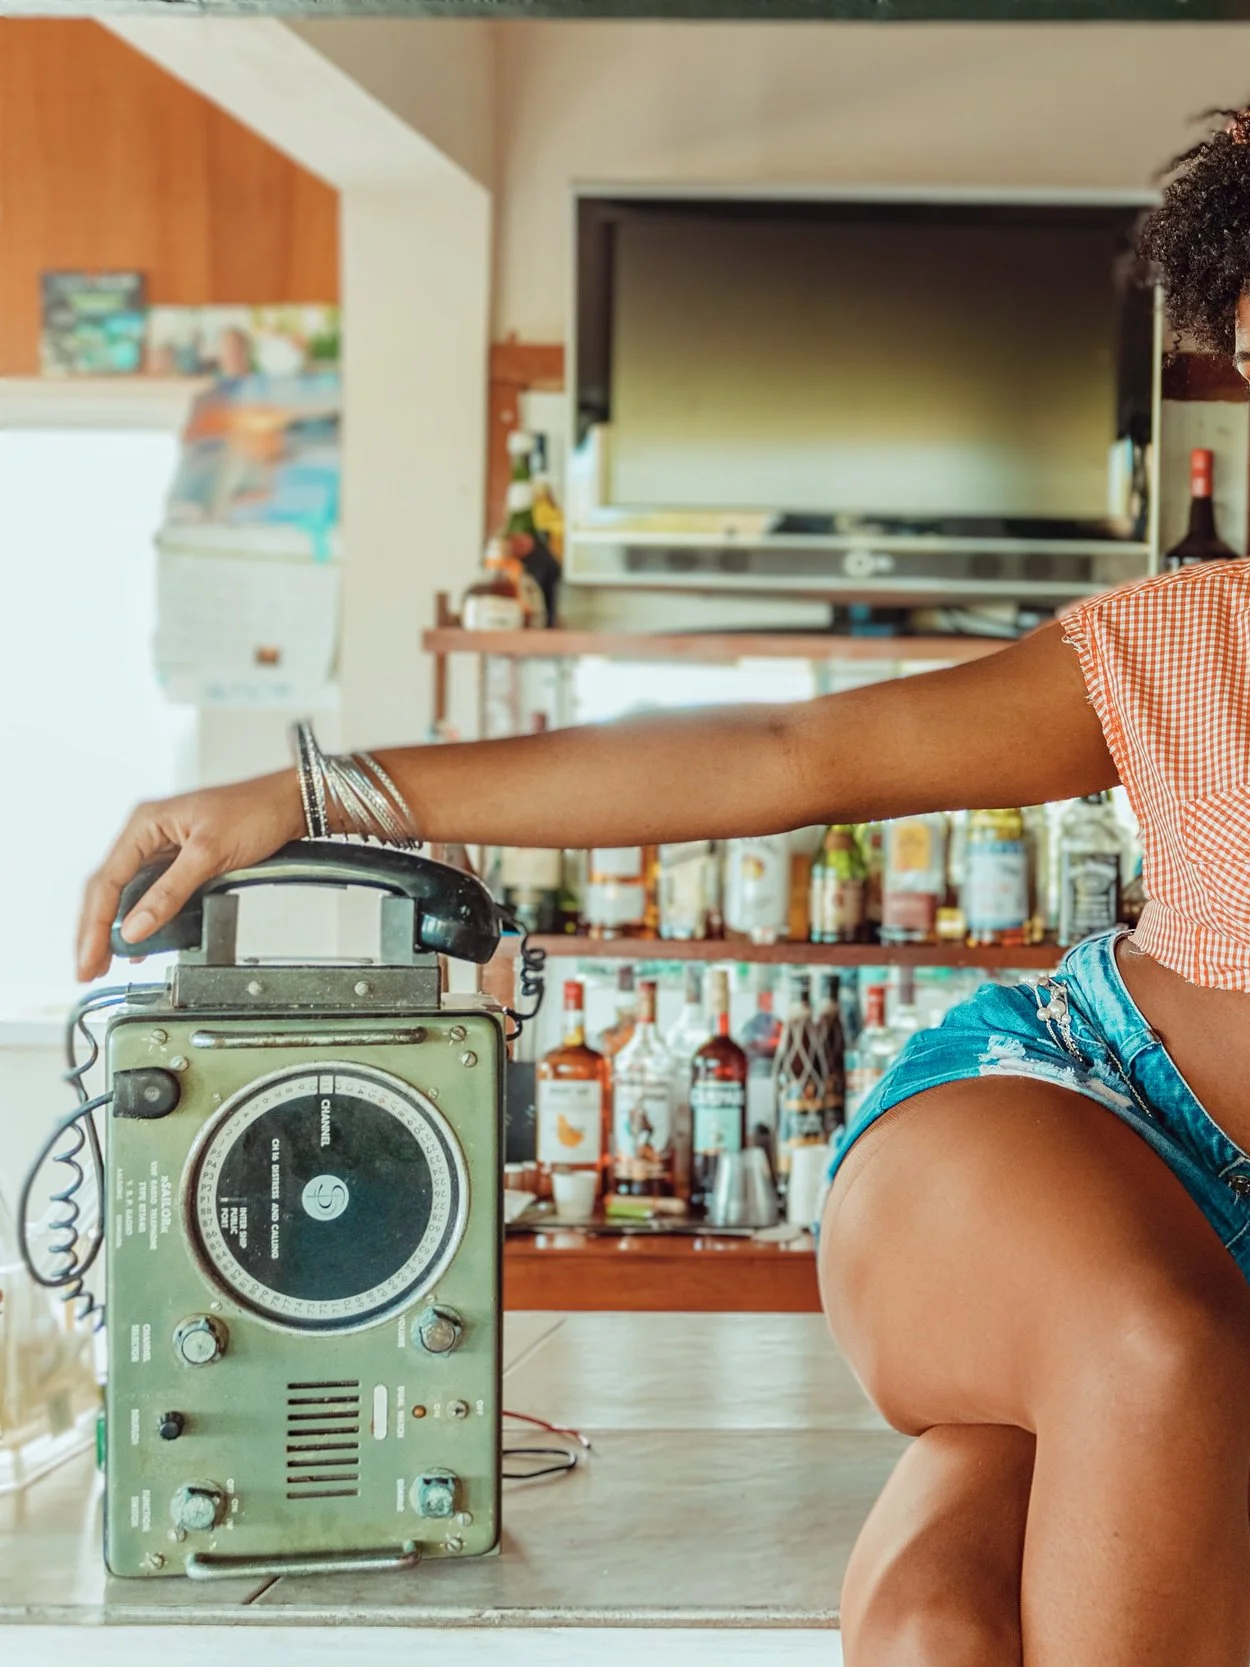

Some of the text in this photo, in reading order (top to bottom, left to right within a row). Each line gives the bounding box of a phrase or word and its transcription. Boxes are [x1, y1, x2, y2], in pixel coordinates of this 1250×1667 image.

[320, 1099, 331, 1148] CHANNEL
[271, 1138, 280, 1259] CH 16 DISTRESS AND CALLING
[221, 1207, 229, 1228] PORT
[230, 1207, 238, 1235] PUBLIC
[239, 1207, 247, 1249] INTER SHIP
[142, 1323, 152, 1362] CHANNEL
[397, 1315, 405, 1348] VOLUME
[396, 1386, 405, 1439] DUAL WATCH
[433, 1404, 441, 1418] ON
[476, 1400, 484, 1416] OFF
[231, 1498, 239, 1513] ON
